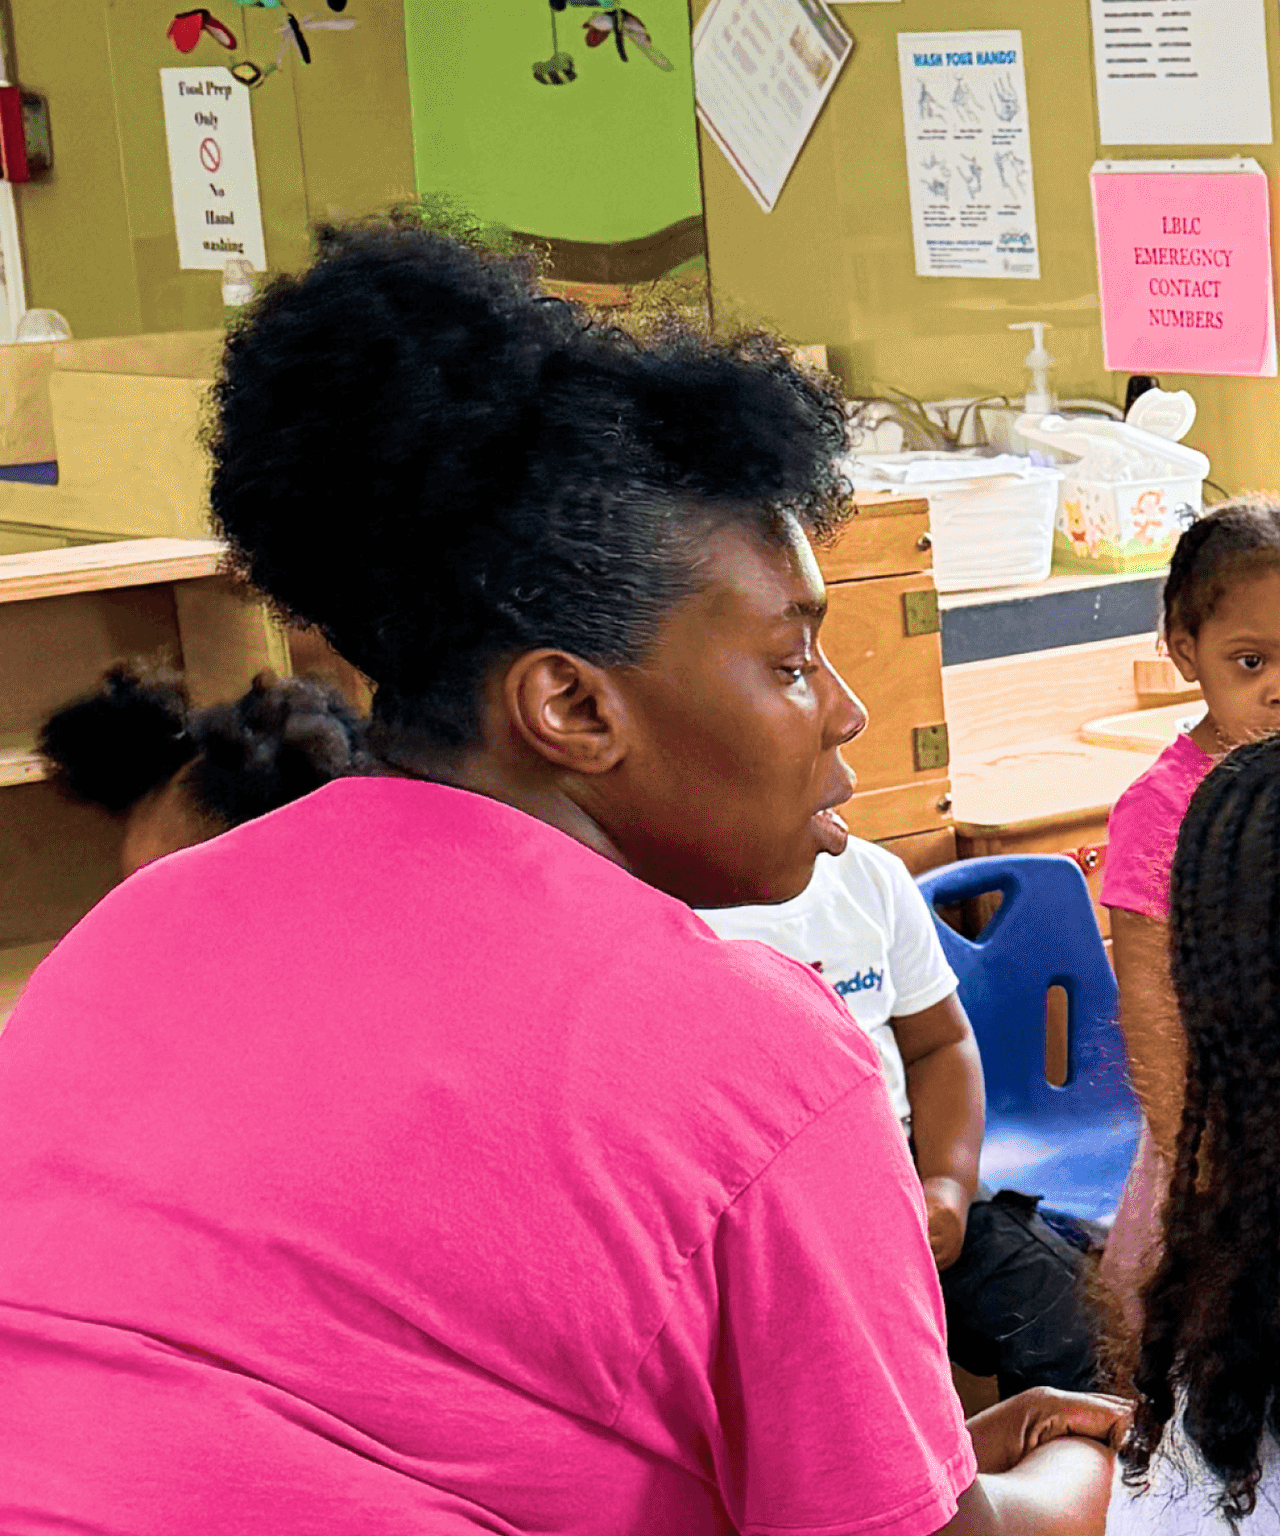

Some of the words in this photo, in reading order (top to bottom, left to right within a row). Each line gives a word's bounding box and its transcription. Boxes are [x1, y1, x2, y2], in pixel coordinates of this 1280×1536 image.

[913, 53, 943, 67] WASH
[945, 52, 973, 66] YOUR
[178, 81, 204, 96] Food
[206, 81, 232, 101] Prep
[194, 111, 219, 131] Only
[208, 182, 226, 198] No
[205, 209, 235, 225] Hand
[1162, 216, 1201, 235] LBLC
[202, 236, 245, 255] washing
[1133, 247, 1233, 267] EMEREGNCY
[1149, 277, 1222, 298] CONTACT
[1149, 308, 1223, 329] NUMBERS
[833, 966, 884, 997] addy
